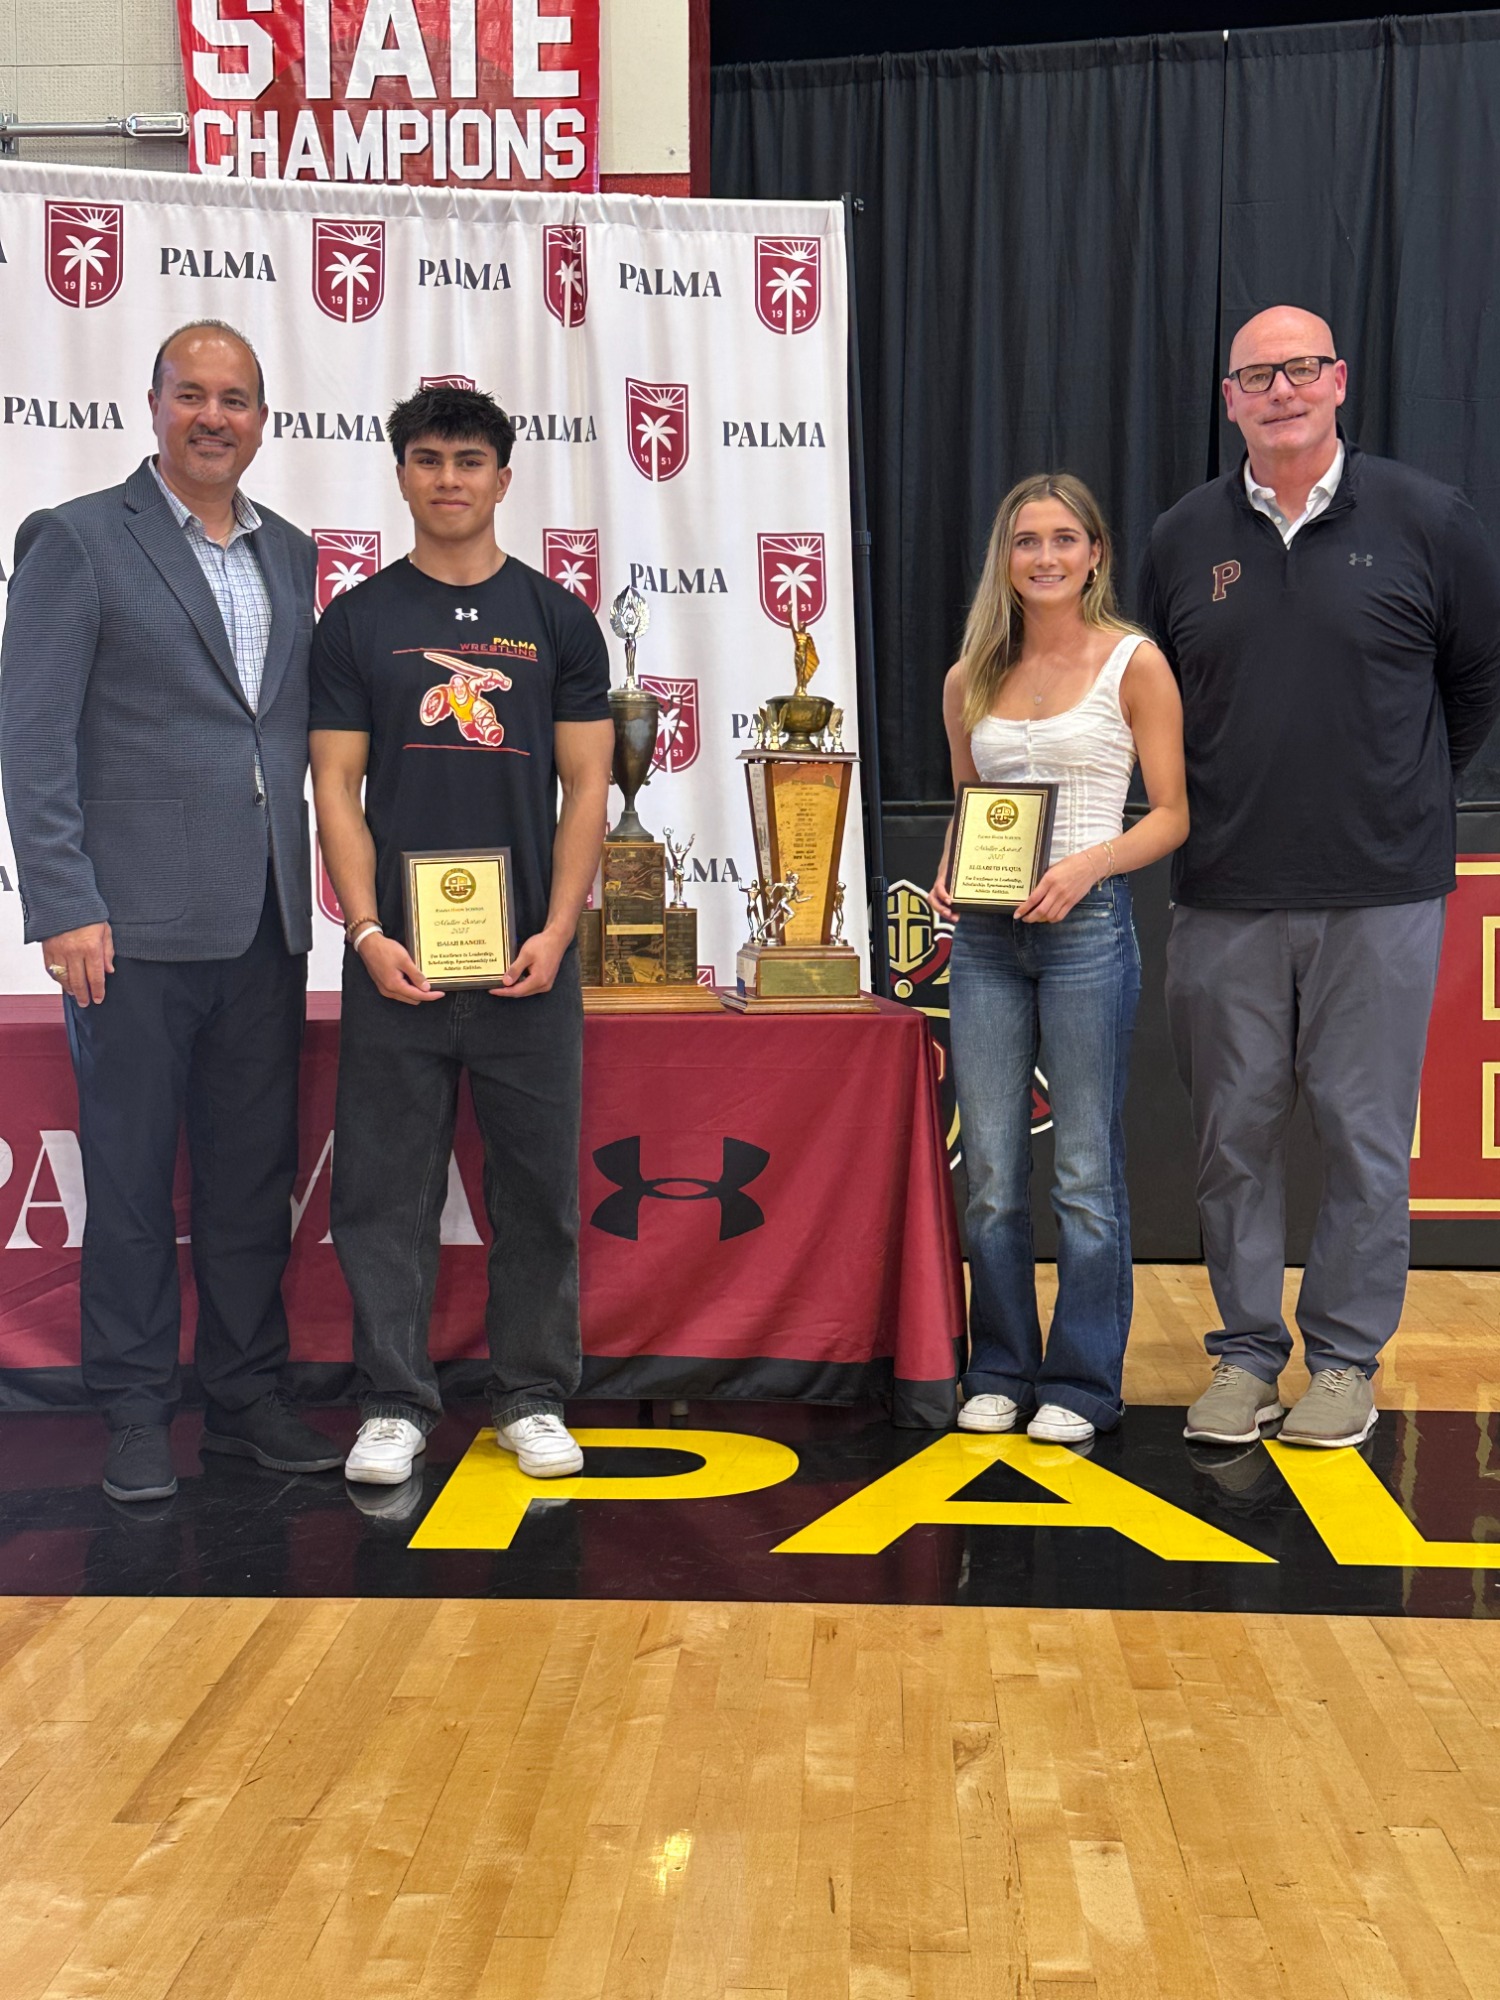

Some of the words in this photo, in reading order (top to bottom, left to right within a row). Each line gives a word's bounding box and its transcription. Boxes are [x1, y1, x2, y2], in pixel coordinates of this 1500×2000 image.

[193, 108, 586, 181] CHAMPIONS
[160, 247, 277, 282] PALMA
[64, 281, 76, 290] 19
[90, 281, 103, 291] 51
[619, 262, 722, 298] PALMA
[331, 295, 343, 305] 19
[356, 296, 369, 306] 51
[771, 309, 783, 319] 19
[795, 308, 807, 319] 51
[3, 396, 124, 430] PALMA
[273, 411, 386, 442] PALMA
[508, 414, 598, 443] PALMA
[723, 421, 826, 448] PALMA
[660, 456, 672, 466] 51
[630, 563, 728, 594] PALMA
[1212, 559, 1241, 602] P
[777, 603, 788, 612] 19
[800, 603, 812, 612] 51
[459, 643, 537, 658] WRESTLING
[493, 637, 537, 651] PALMA
